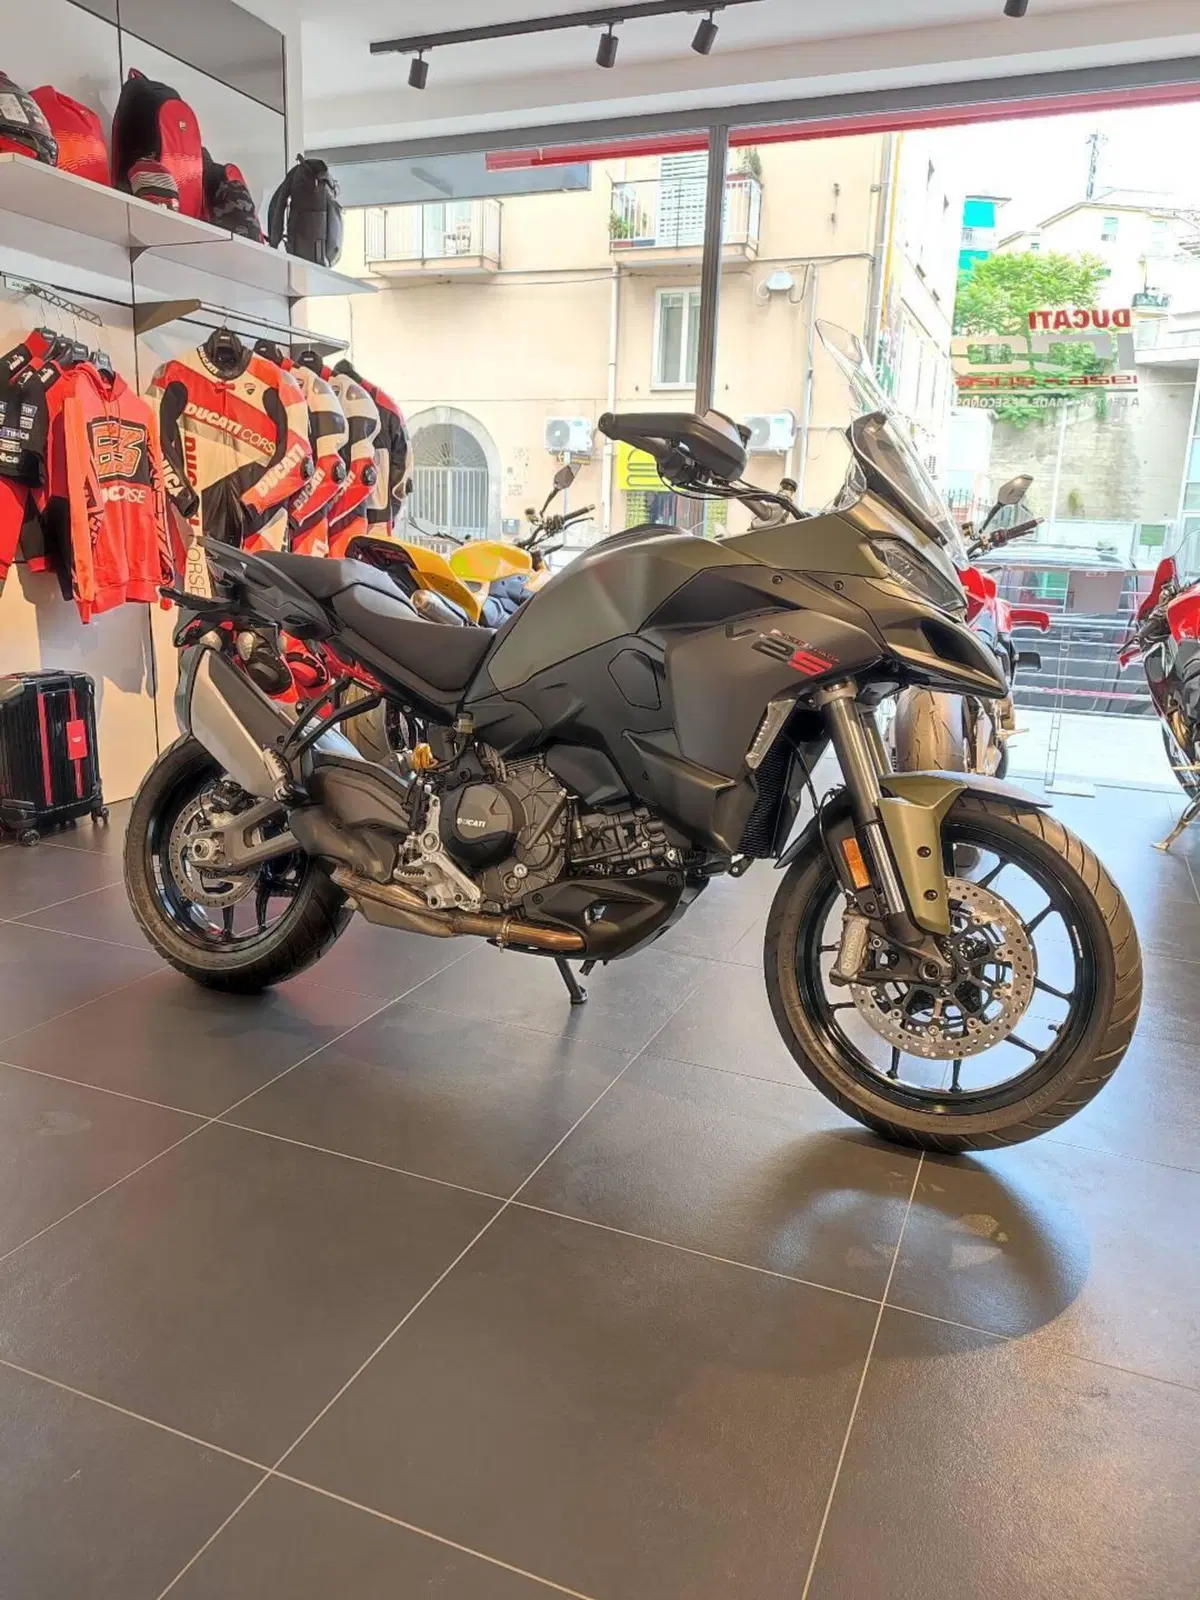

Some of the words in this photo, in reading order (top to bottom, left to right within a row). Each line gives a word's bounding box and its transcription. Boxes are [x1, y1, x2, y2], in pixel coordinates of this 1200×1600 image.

[198, 346, 220, 374] DUCATI
[184, 402, 242, 437] DUCATI
[241, 428, 276, 453] CORS
[256, 443, 305, 497] DUCATI
[293, 467, 326, 509] DUCATI
[456, 817, 487, 828] DUCATI
